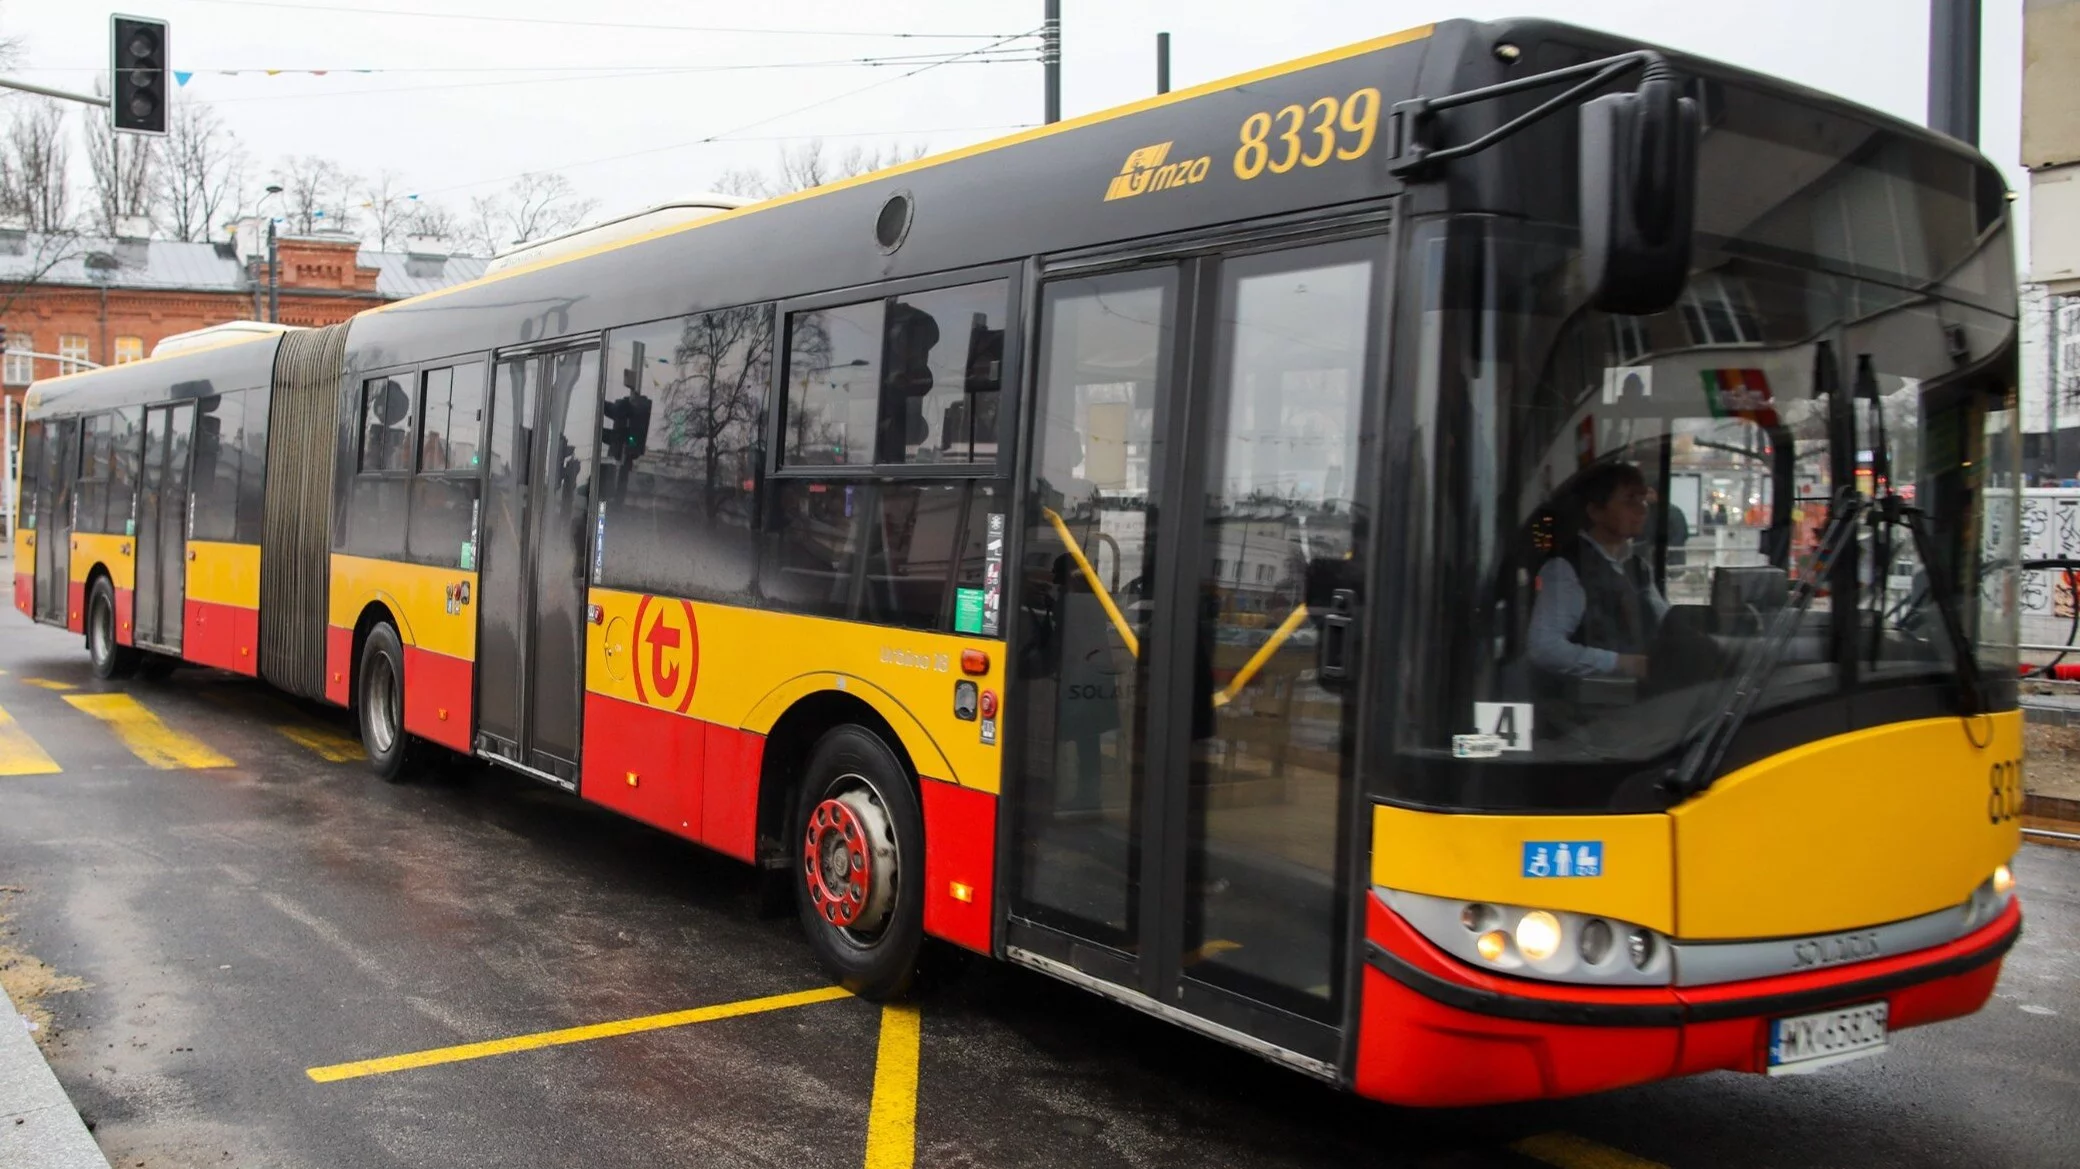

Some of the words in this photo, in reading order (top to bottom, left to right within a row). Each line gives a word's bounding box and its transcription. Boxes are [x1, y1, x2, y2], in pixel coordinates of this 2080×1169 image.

[1233, 87, 1381, 181] 8339
[1148, 155, 1211, 192] mza
[1495, 706, 1519, 747] 4
